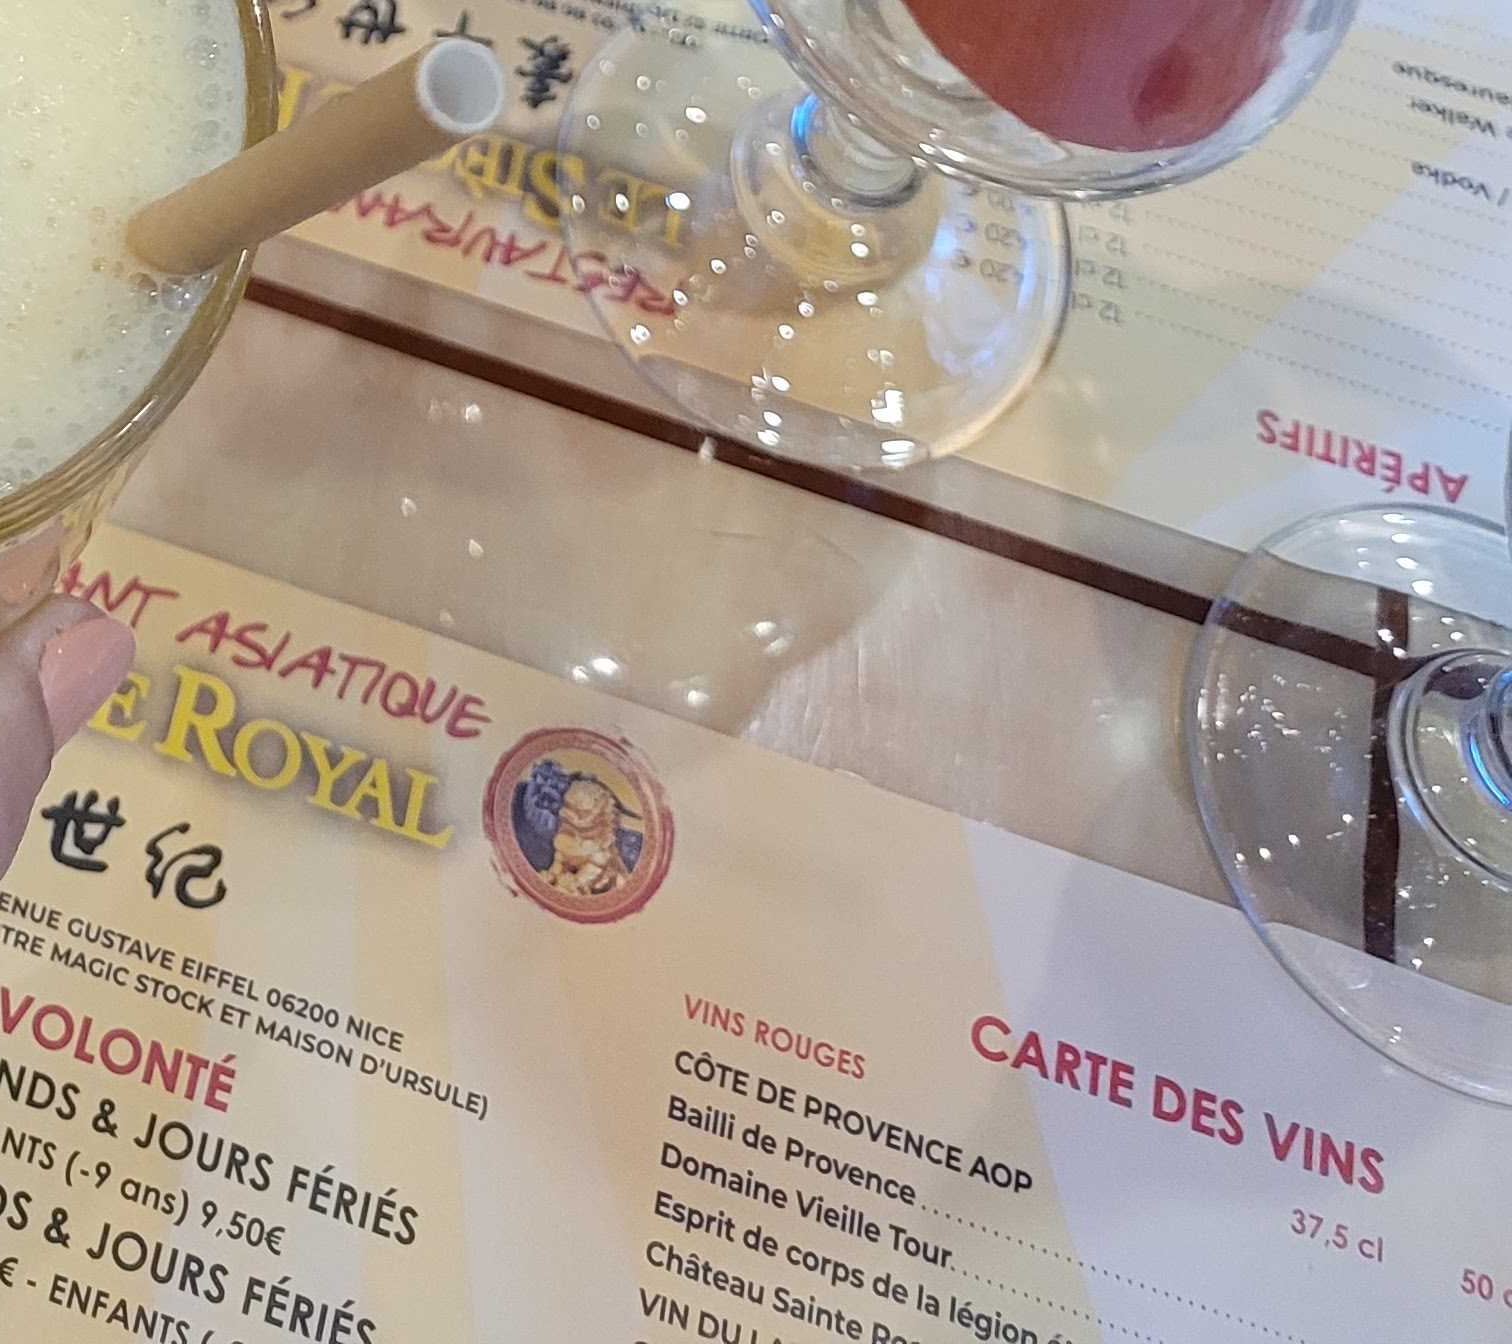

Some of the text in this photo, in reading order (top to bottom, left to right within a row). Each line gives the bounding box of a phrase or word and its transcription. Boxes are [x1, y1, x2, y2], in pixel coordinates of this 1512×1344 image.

[1411, 161, 1492, 201] Vodka
[1256, 408, 1470, 506] APÉRITIFS
[174, 608, 494, 739] ASIATIQUE
[50, 941, 130, 987] MAGIC
[133, 973, 215, 1018] STOCK
[219, 1004, 252, 1029] ET
[254, 1014, 355, 1068] MAISON
[359, 1053, 489, 1121] D'URSULE)
[67, 916, 177, 971] GUSTAVE
[181, 956, 259, 1002] EIFFEL
[266, 987, 340, 1029] 06200
[345, 1014, 405, 1053] NICE
[684, 993, 867, 1080] VINS ROUGES
[0, 984, 238, 1113] VOLONTÉ
[970, 1014, 1386, 1195] CARTE DES VINS
[91, 1098, 119, 1138] &
[133, 1112, 275, 1193] JOURS
[286, 1163, 419, 1246] FÉRIÉS
[666, 1094, 916, 1206] Bailli de Provence
[674, 1049, 1034, 1195] CÔTE DE PROVENCE AOP
[64, 1149, 113, 1190] (-9
[119, 1174, 190, 1227] ans)
[200, 1198, 287, 1257] 9,50€
[660, 1141, 953, 1269] Domaine Vieille Tour
[1290, 1208, 1384, 1263] 37,5 cl
[42, 1206, 71, 1250] &
[85, 1221, 230, 1305] JOURS
[241, 1274, 378, 1344] FÉRIÉS
[48, 1273, 192, 1344] ENFANTS
[639, 1286, 742, 1344] VIN DU
[645, 1240, 864, 1341] Château Sainte
[654, 1189, 736, 1243] Esprit
[742, 1225, 779, 1257] de
[785, 1243, 865, 1288] corps
[872, 1272, 909, 1305] de
[916, 1283, 941, 1318] la
[949, 1295, 1039, 1344] légion
[1459, 1267, 1495, 1301] 50
